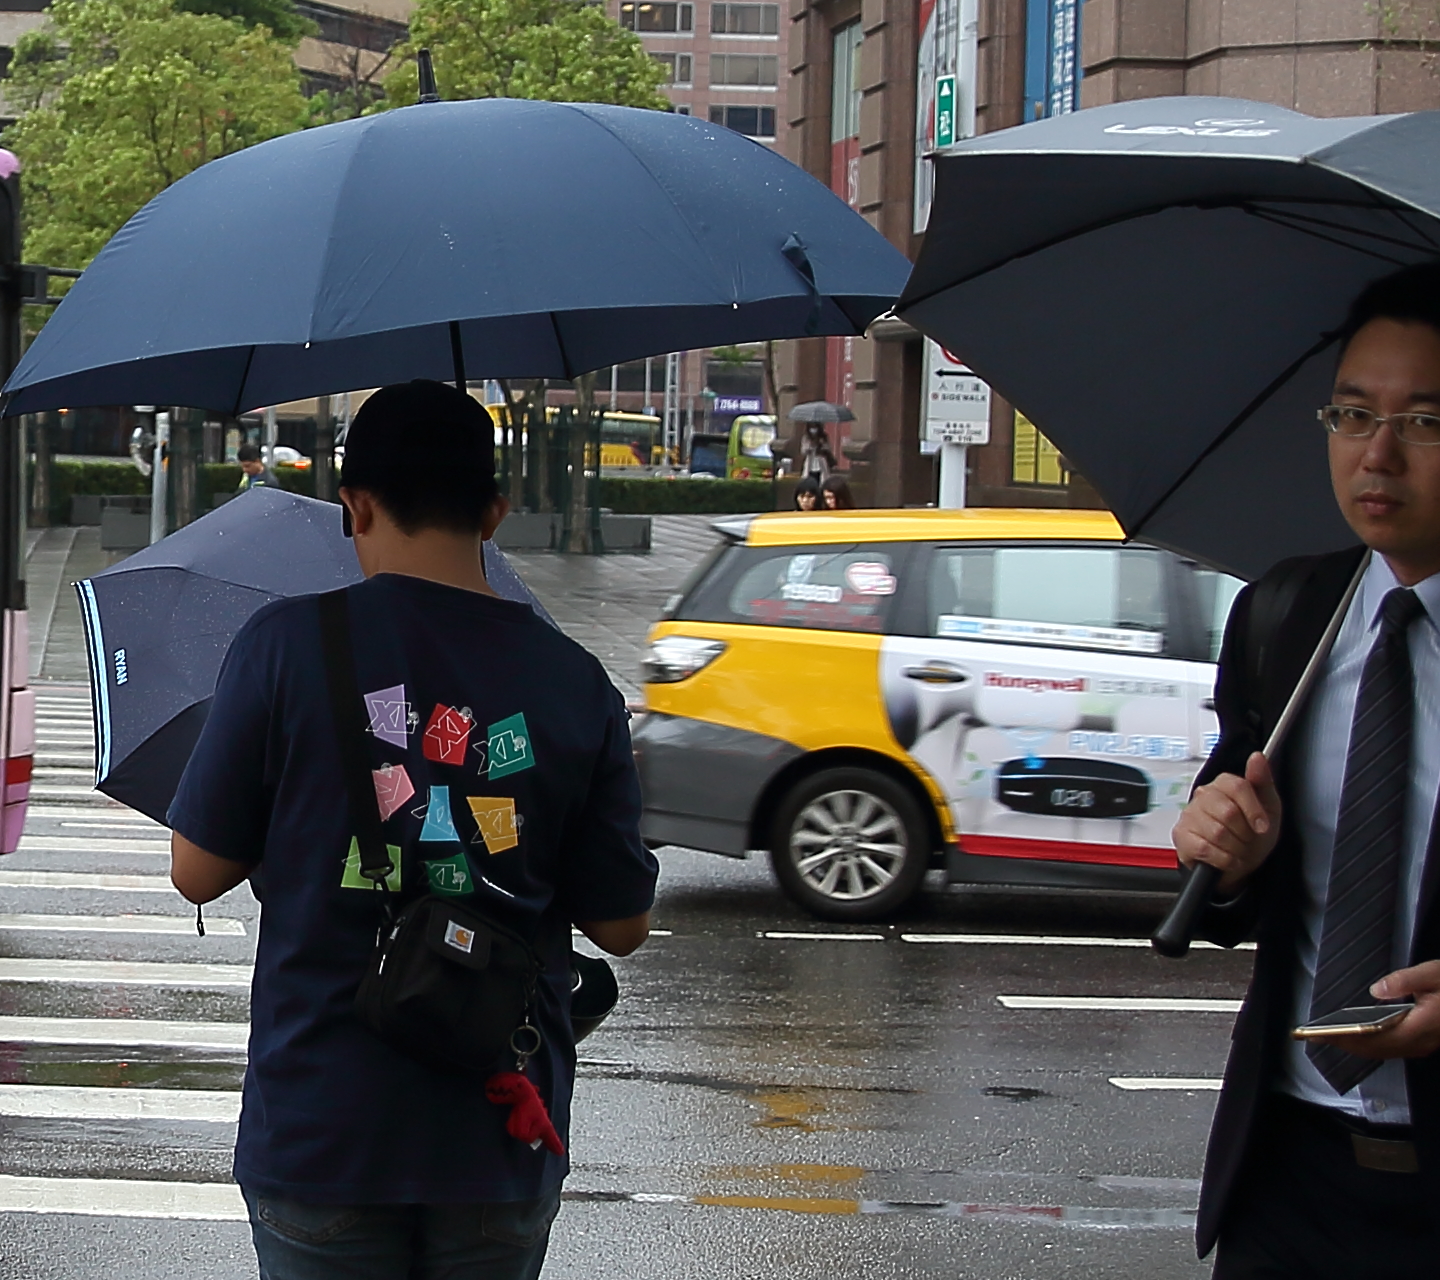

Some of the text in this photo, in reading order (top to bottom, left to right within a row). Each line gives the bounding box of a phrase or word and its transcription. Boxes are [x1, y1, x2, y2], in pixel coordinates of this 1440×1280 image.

[941, 393, 987, 401] SIDEWALK
[114, 648, 128, 686] RYAN
[983, 671, 1087, 693] Honeywell
